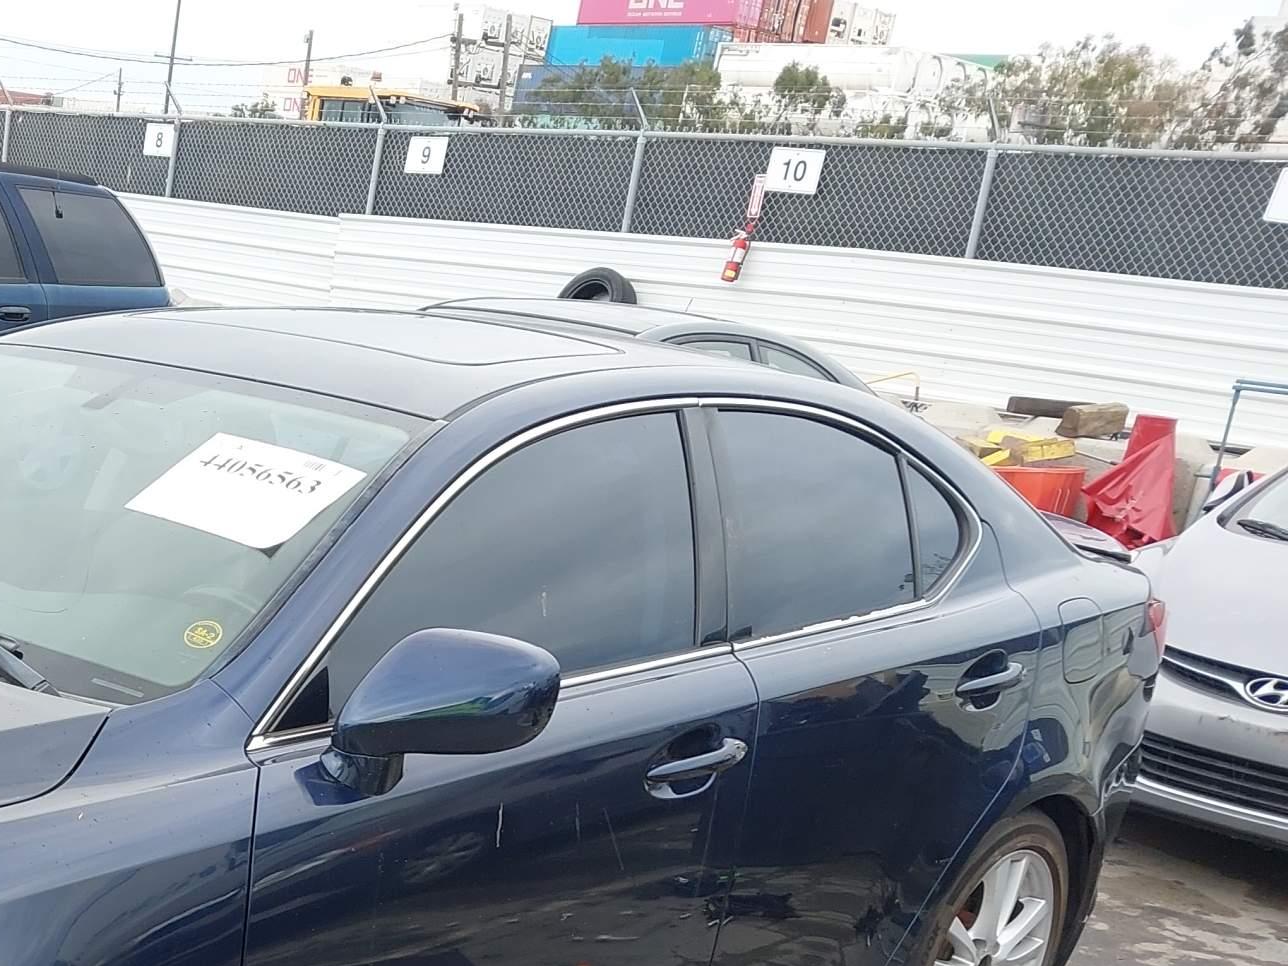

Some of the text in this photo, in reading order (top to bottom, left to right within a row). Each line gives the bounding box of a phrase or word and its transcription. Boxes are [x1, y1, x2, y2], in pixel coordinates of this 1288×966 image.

[288, 68, 314, 83] ONE
[155, 131, 164, 148] 8
[421, 146, 431, 165] 9
[783, 159, 807, 182] 10
[199, 453, 323, 494] 44056563
